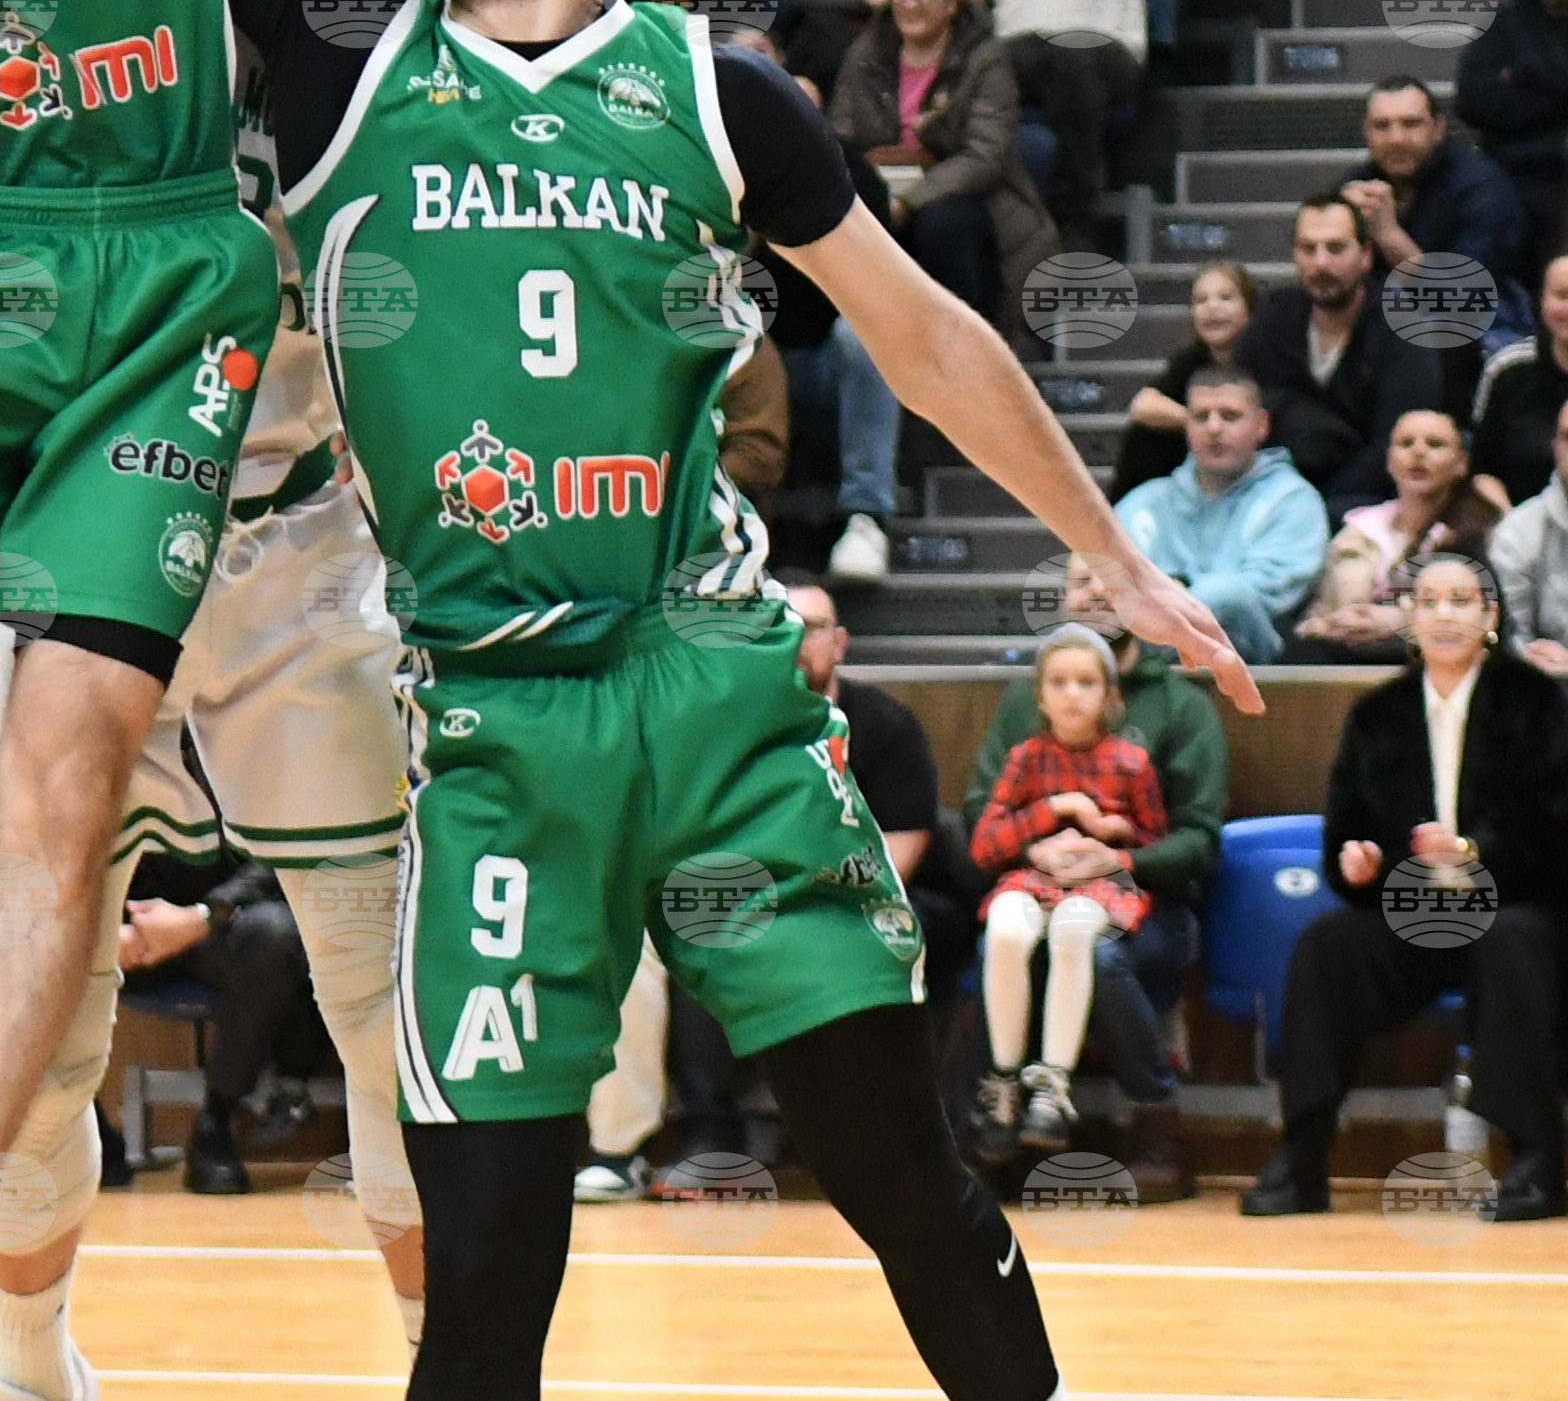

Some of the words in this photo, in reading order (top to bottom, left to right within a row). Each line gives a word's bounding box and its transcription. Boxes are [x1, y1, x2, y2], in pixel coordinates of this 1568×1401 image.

[68, 24, 178, 110] MI
[411, 163, 670, 242] BALKAN
[517, 269, 578, 378] 9
[108, 437, 231, 500] efbet
[470, 853, 529, 960] 9
